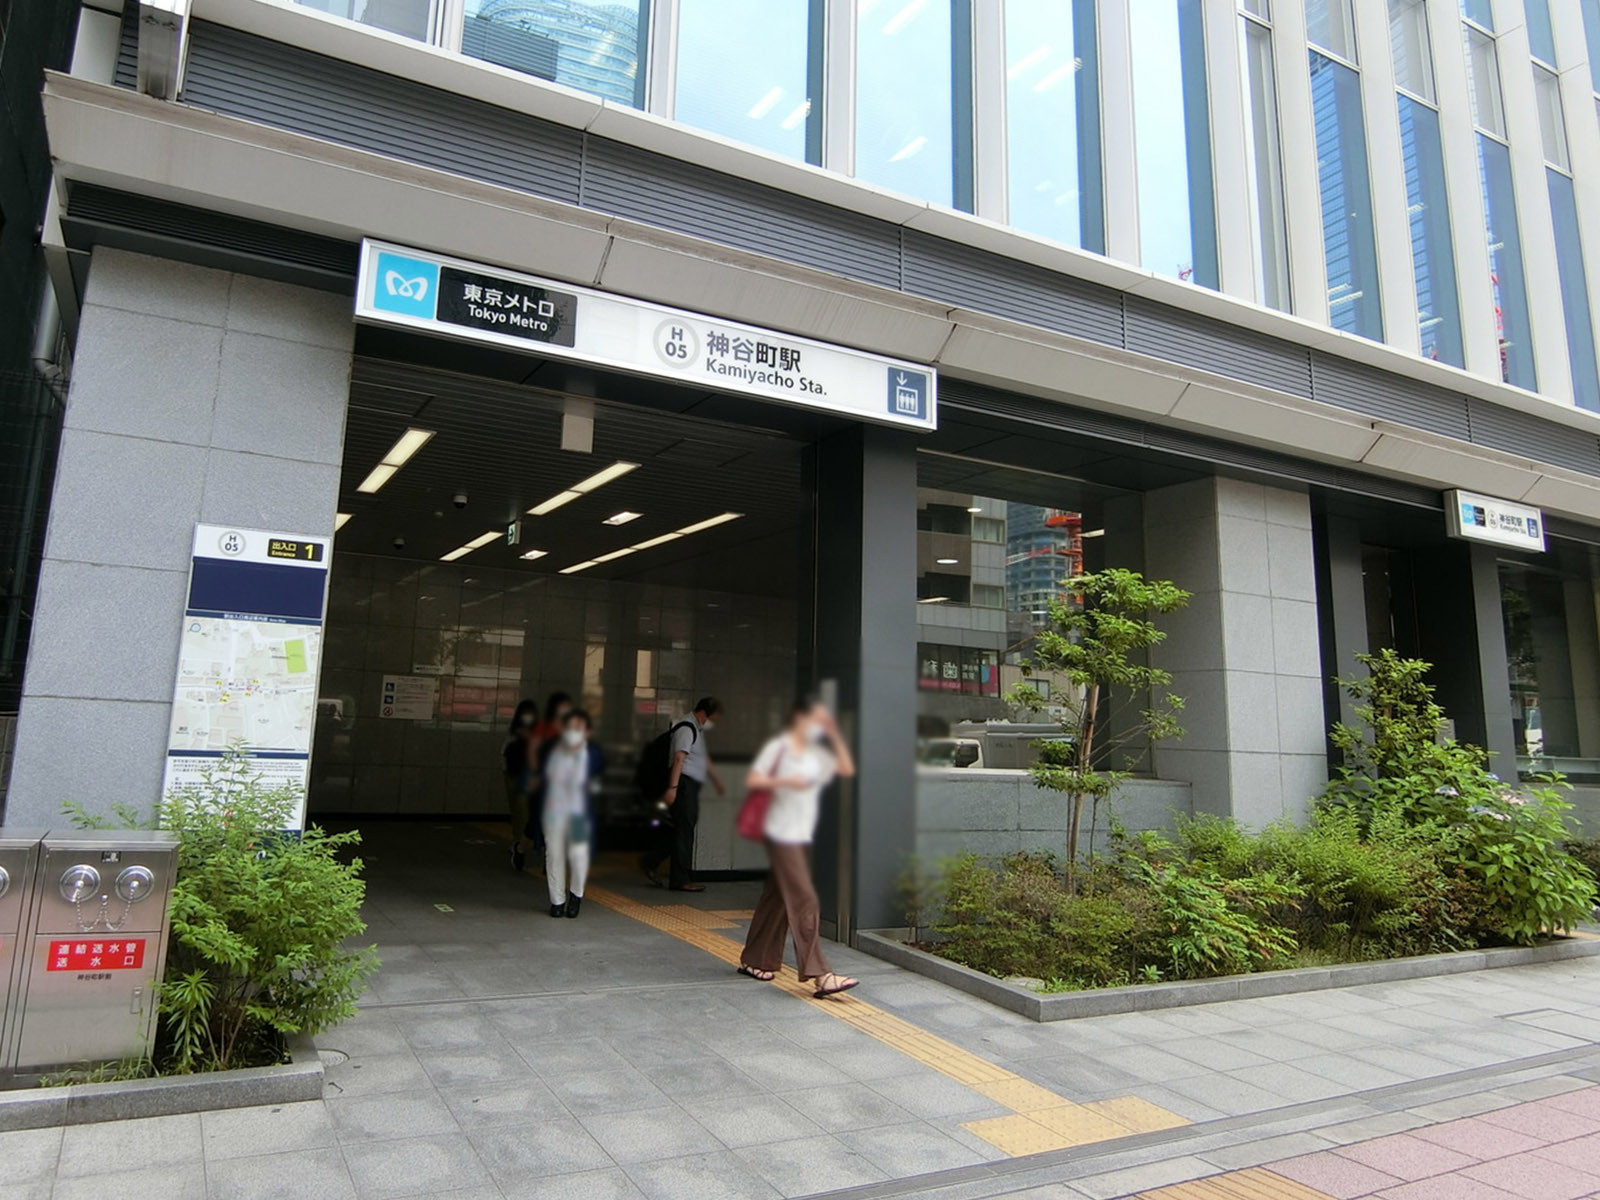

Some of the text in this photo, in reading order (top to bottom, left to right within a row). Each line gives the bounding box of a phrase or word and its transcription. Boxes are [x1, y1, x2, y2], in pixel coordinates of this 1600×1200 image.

[463, 283, 555, 318] 東京メトロ
[468, 304, 548, 332] Tokyo Metro
[671, 326, 684, 342] H
[664, 341, 688, 360] 05
[706, 330, 802, 373] 神谷町駅
[706, 357, 828, 396] Kamiyacho Sta.
[224, 543, 238, 551] 05
[229, 534, 237, 543] H
[272, 541, 314, 560] 出入口 1
[58, 942, 136, 954] 連結送水管
[56, 956, 135, 967] 送水口
